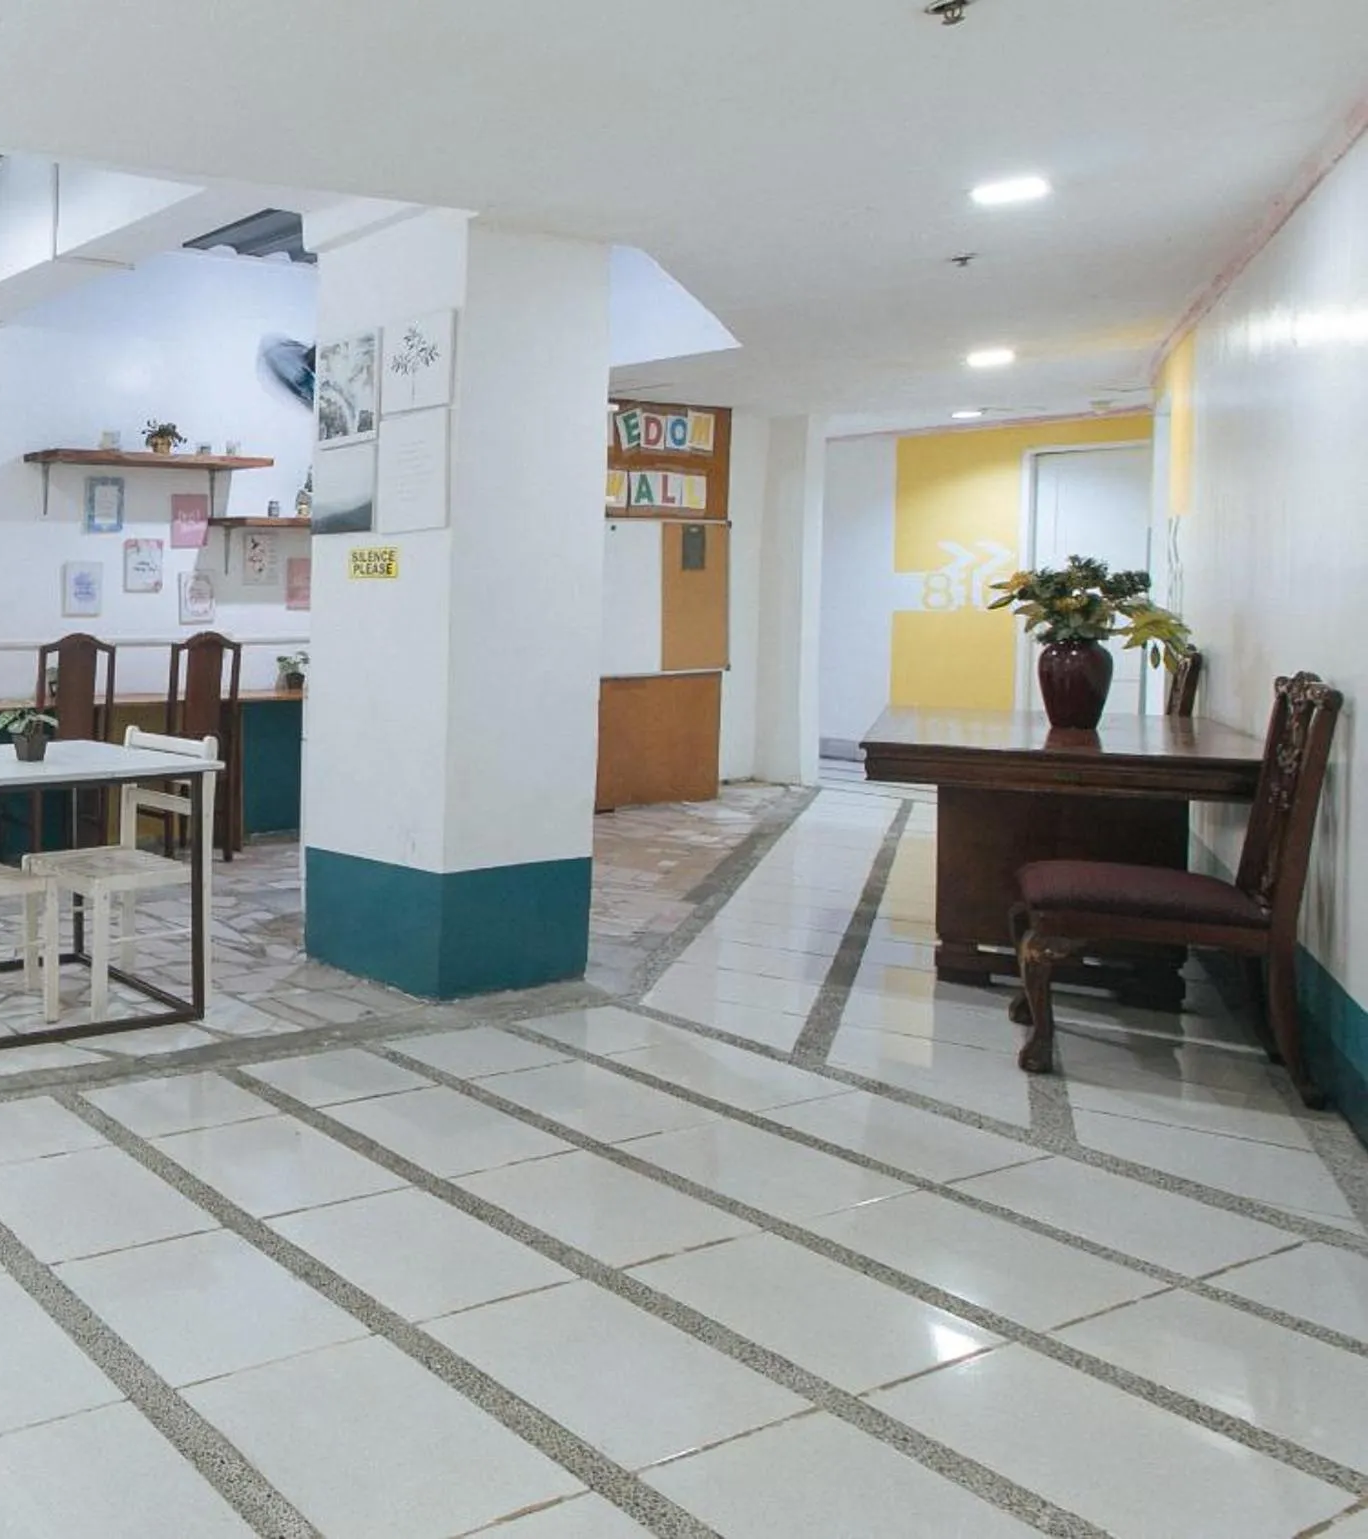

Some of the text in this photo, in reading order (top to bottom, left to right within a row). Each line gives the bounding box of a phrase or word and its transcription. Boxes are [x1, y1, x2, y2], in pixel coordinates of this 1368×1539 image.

[622, 410, 712, 447] EDOM
[351, 549, 396, 562] SILENCE
[352, 562, 394, 575] PLEASE
